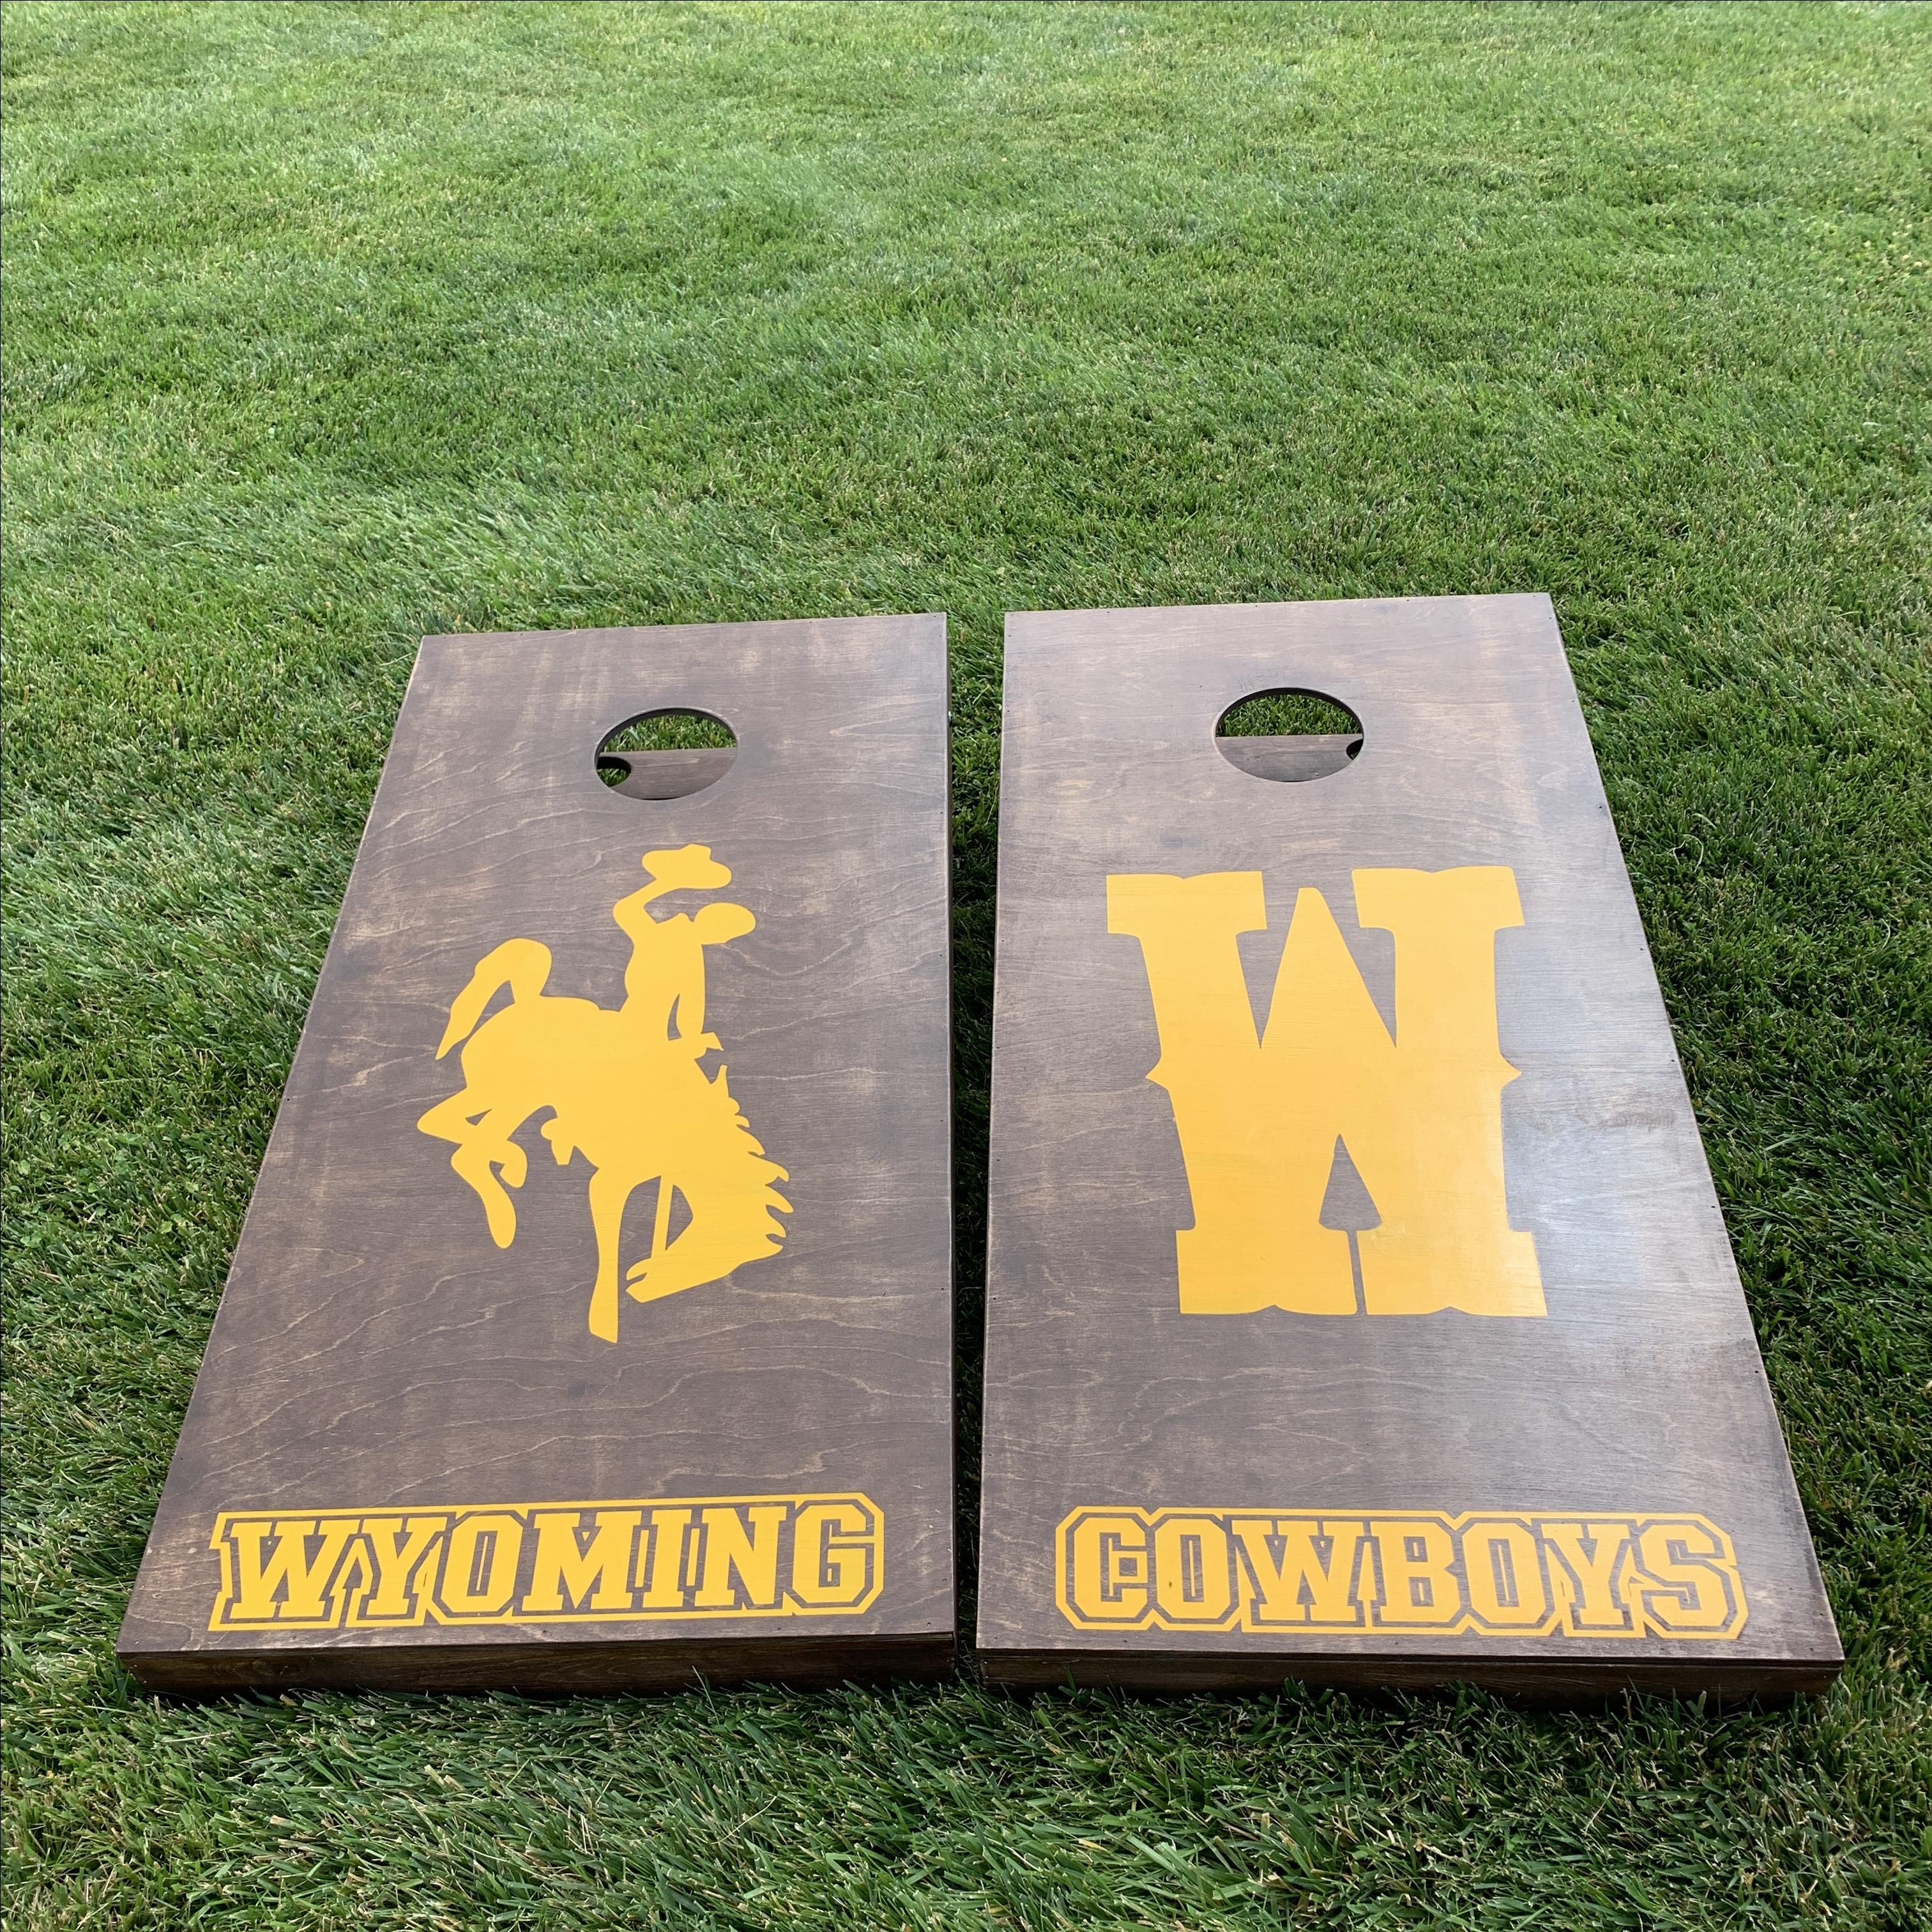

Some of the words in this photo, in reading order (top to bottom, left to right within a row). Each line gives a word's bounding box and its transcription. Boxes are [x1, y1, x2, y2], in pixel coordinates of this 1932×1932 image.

[1106, 866, 1548, 1317] W
[209, 1493, 885, 1632] WYOMING
[1056, 1507, 1748, 1641] COWBOYS
